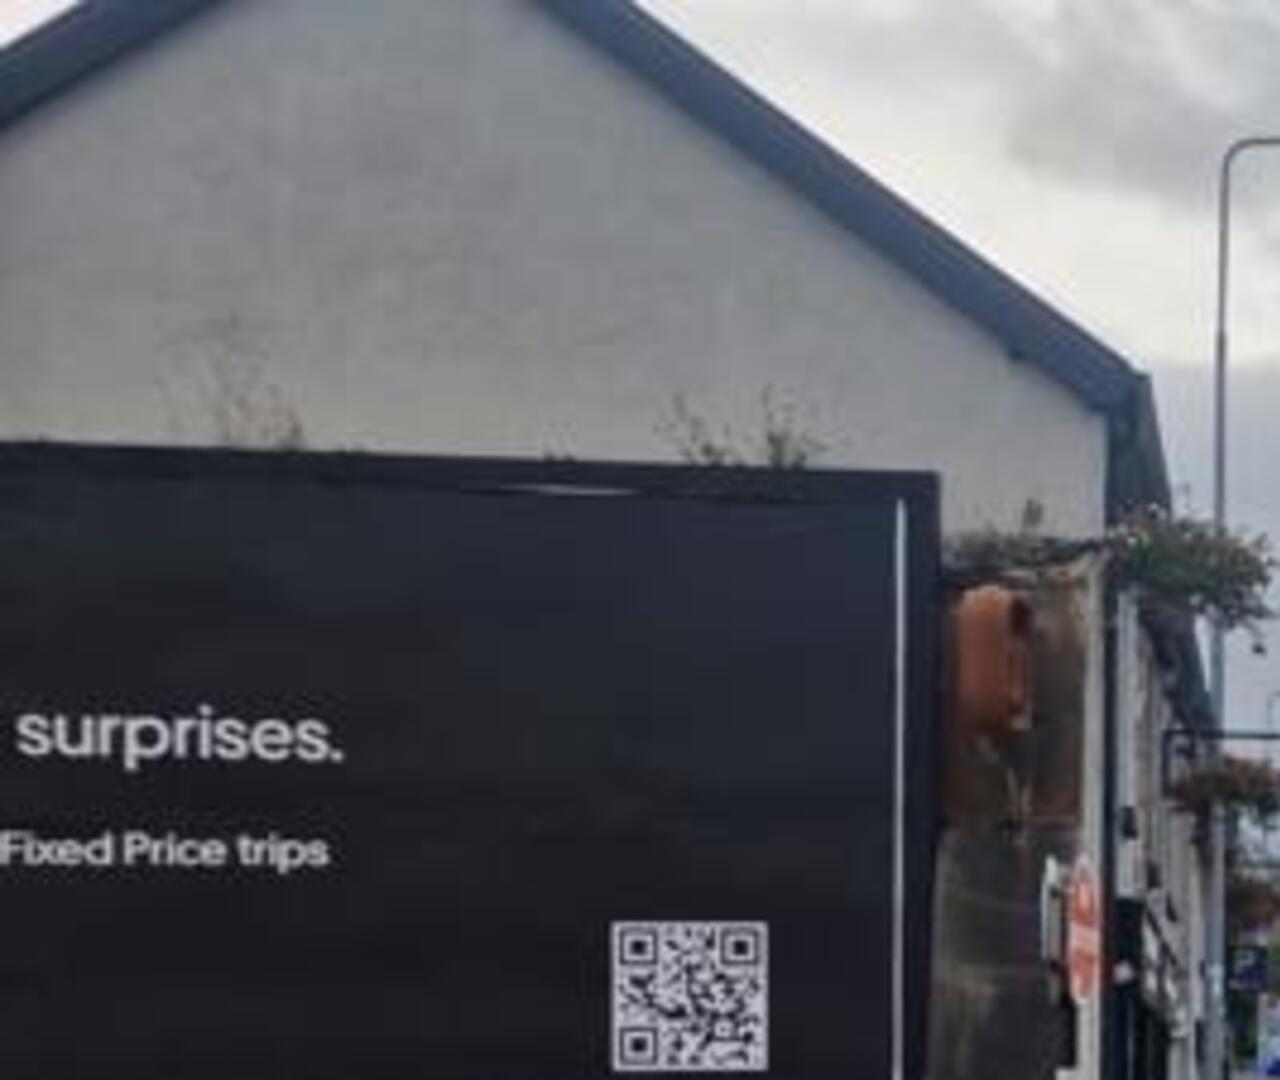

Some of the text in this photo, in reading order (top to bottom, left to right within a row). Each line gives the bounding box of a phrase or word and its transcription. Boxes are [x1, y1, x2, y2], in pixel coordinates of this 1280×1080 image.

[16, 703, 344, 772] surprises.
[0, 829, 331, 876] Fixed Price trips
